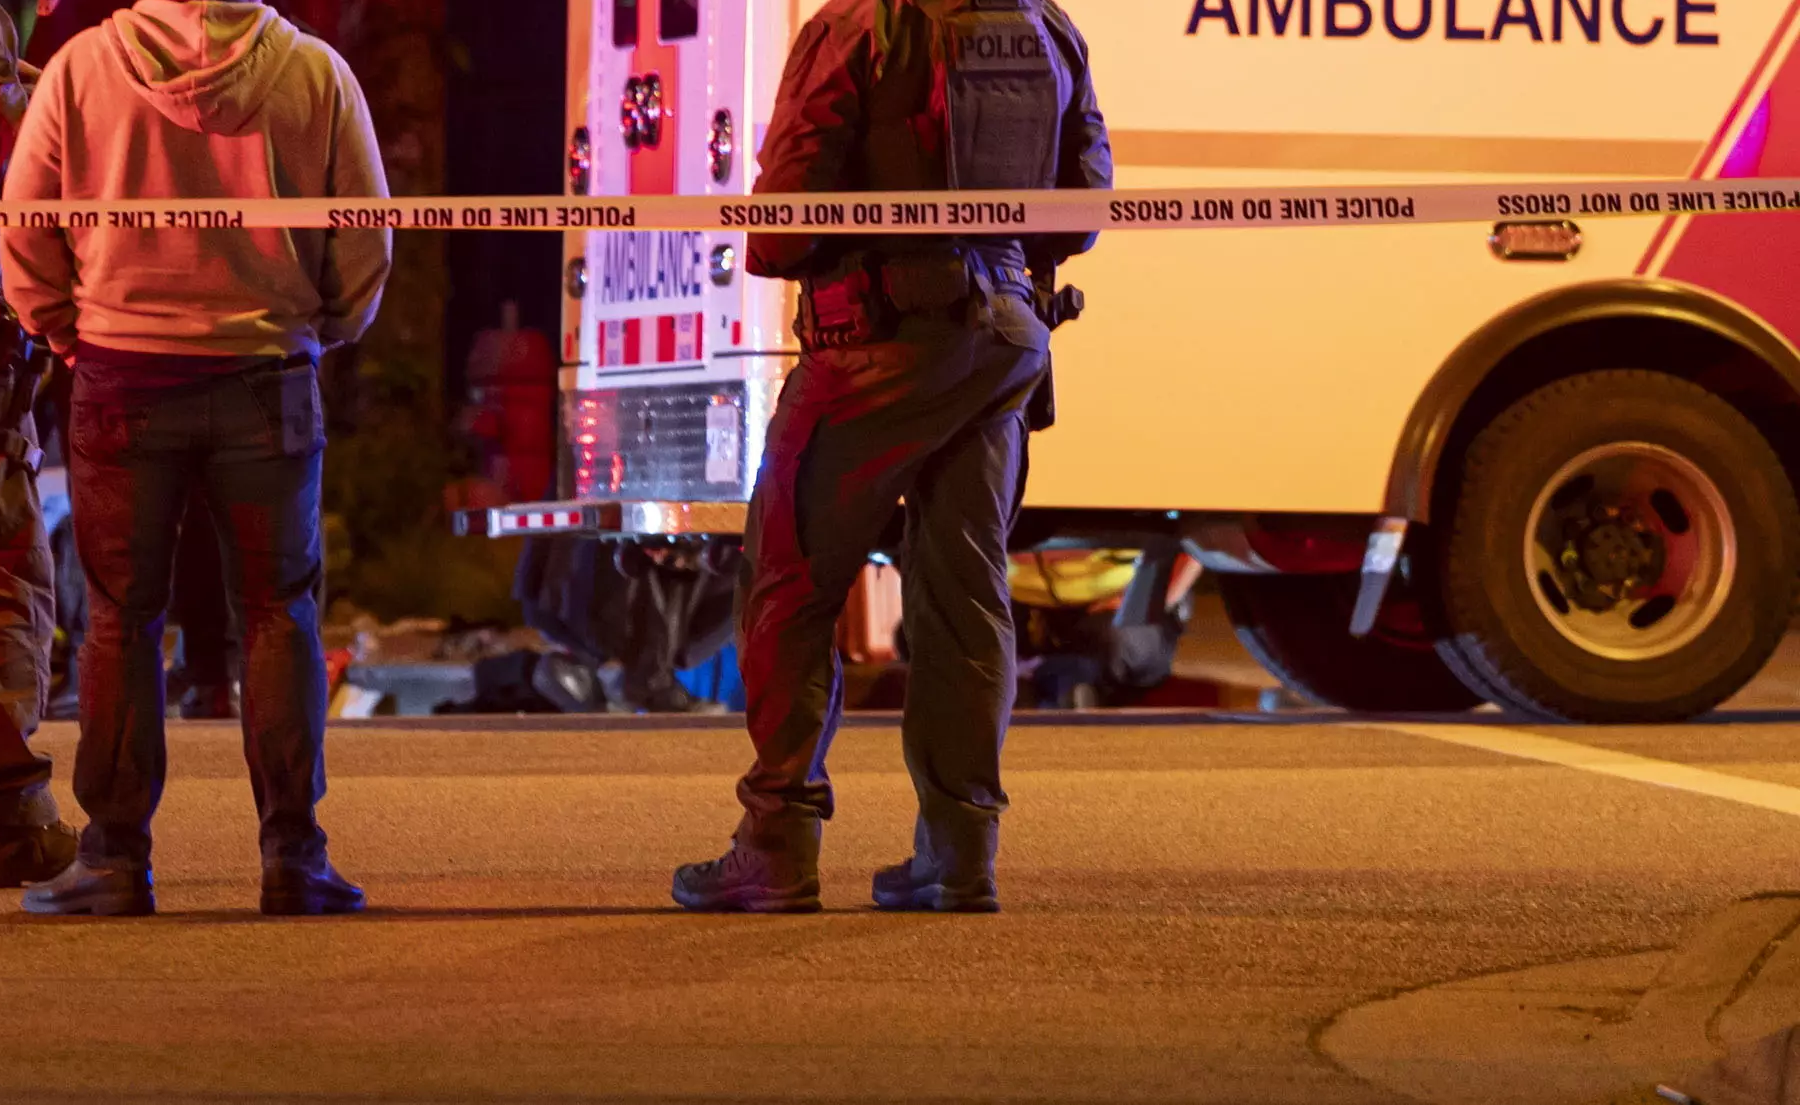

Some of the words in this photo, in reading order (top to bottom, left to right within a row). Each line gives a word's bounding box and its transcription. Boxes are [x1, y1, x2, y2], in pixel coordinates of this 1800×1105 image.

[960, 34, 1048, 59] POLICE
[1190, 199, 1233, 221] NOT
[1242, 199, 1272, 220] DO
[1279, 198, 1328, 219] LINE
[1336, 197, 1414, 219] POLICE
[1497, 194, 1571, 216] CROSS
[1578, 192, 1622, 214] NOT
[1629, 192, 1660, 213] DO
[1667, 191, 1716, 212] LINE
[1723, 190, 1800, 210] POLICE
[18, 211, 60, 228] NOT
[69, 211, 98, 228] DO
[107, 211, 155, 228] LINE
[164, 210, 243, 228] POLICE
[328, 208, 401, 228] CROSS
[411, 207, 453, 227] NOT
[462, 207, 491, 227] DO
[500, 207, 548, 227] LINE
[556, 206, 635, 227] POLICE
[720, 204, 793, 226] CROSS
[800, 203, 845, 225] NOT
[853, 203, 883, 225] DO
[890, 203, 939, 224] LINE
[946, 202, 1026, 224] POLICE
[1109, 200, 1182, 222] CROSS
[602, 231, 702, 304] AMBULANCE
